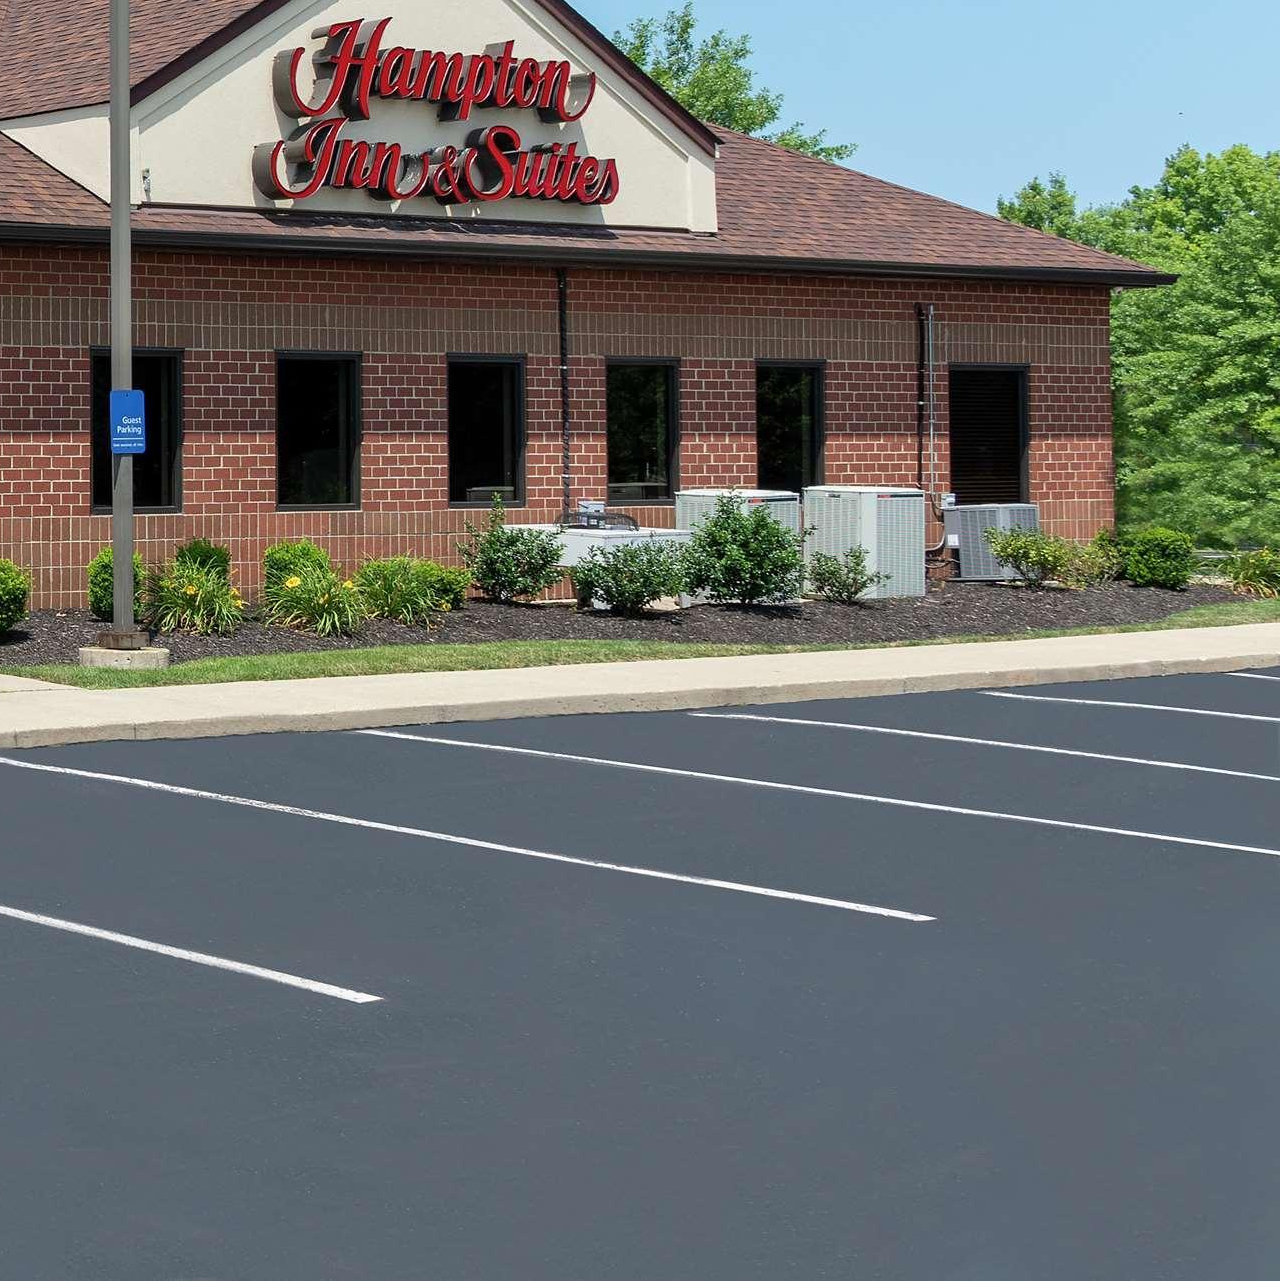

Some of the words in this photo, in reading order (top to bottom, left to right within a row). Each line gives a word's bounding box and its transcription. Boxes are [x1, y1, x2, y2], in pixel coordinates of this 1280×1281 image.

[288, 16, 597, 123] Hampton
[269, 116, 430, 201] Inn
[433, 143, 470, 205] &
[463, 124, 620, 206] Suites
[116, 425, 142, 435] Parking
[121, 416, 142, 424] Guest
